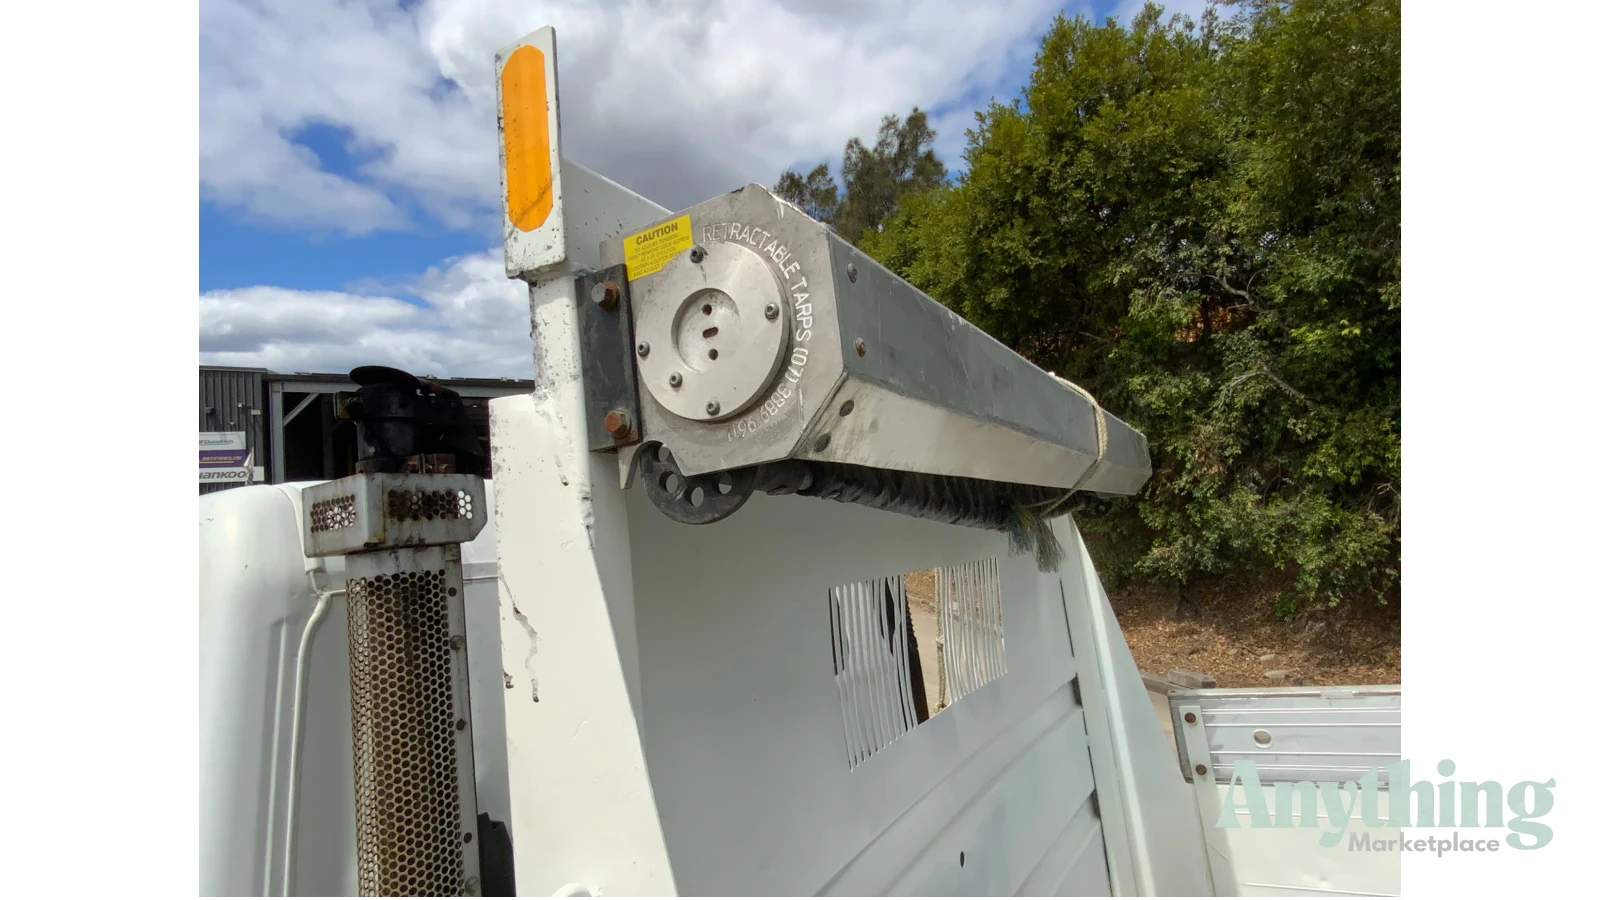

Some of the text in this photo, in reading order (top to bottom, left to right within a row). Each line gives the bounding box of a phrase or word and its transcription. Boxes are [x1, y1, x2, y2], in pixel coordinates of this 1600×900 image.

[636, 222, 678, 245] CAUTION
[702, 222, 800, 280] RETRACTABLE
[791, 276, 813, 341] TARPS
[785, 347, 808, 383] (07)
[760, 382, 792, 422] 3889
